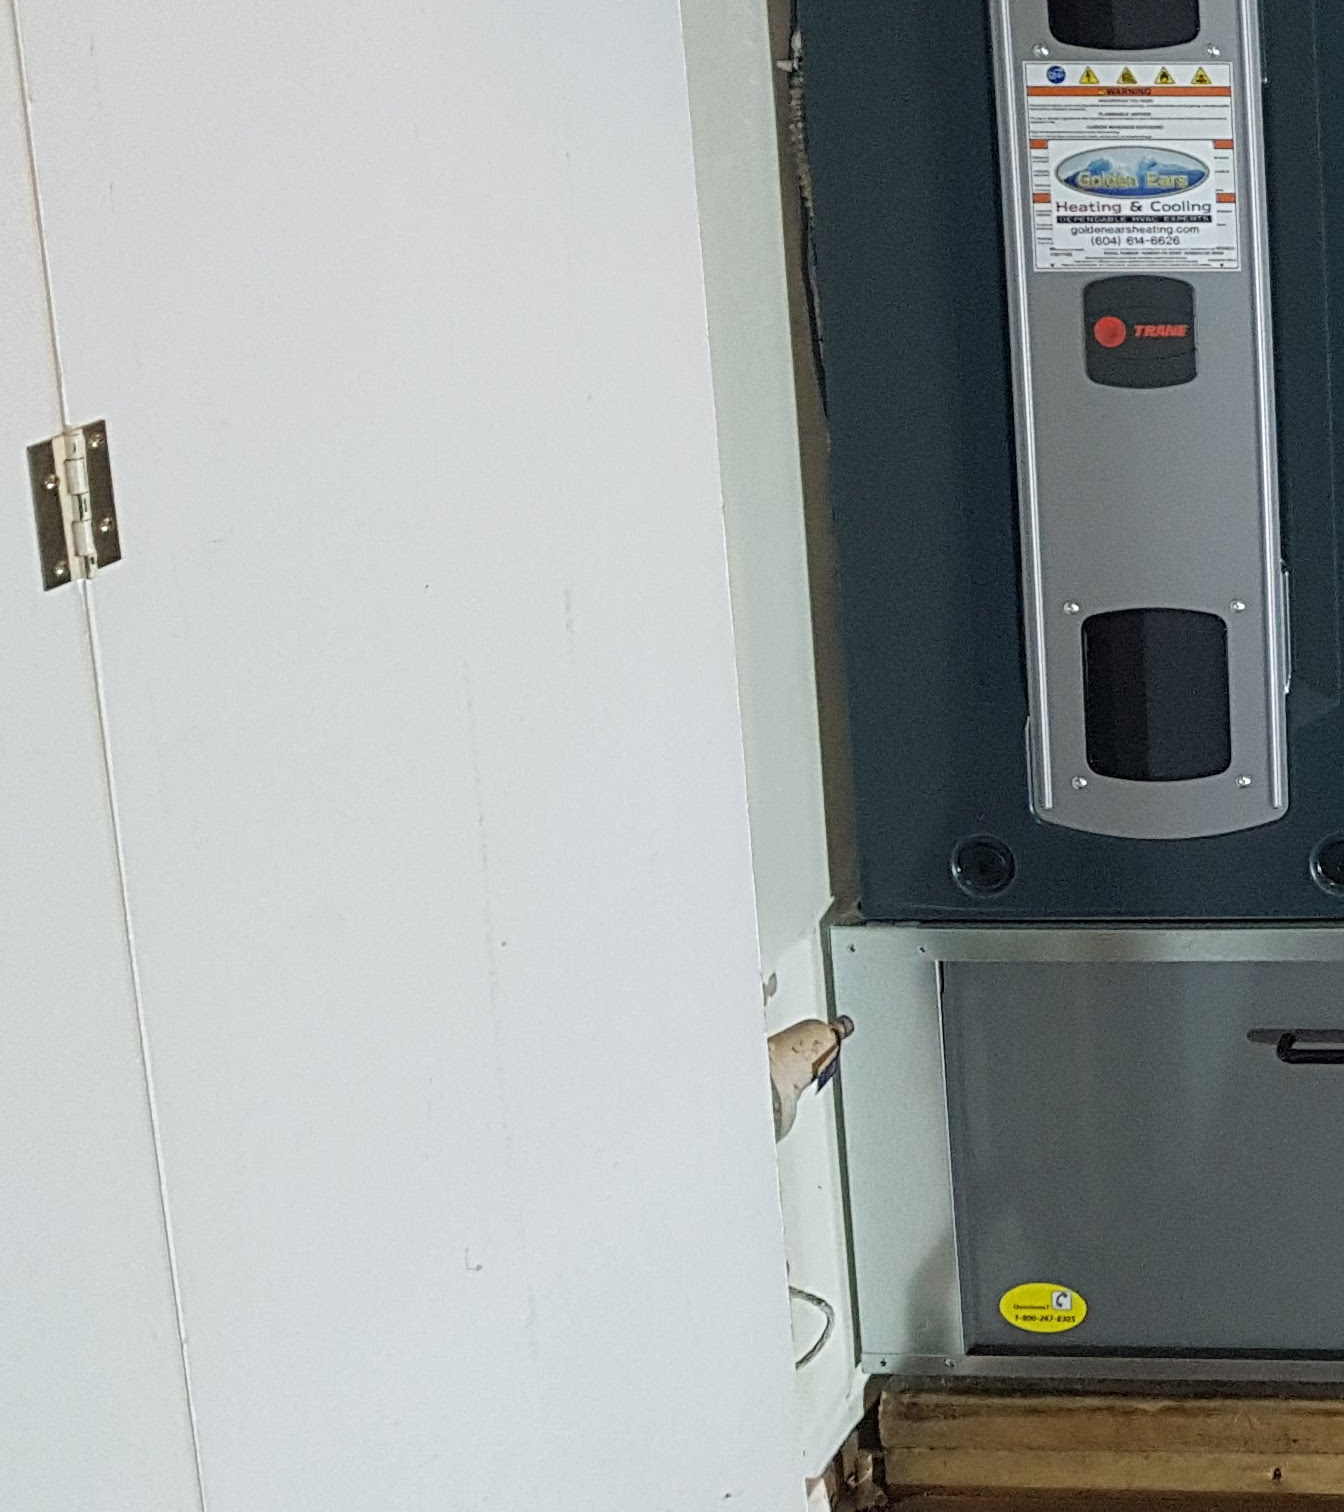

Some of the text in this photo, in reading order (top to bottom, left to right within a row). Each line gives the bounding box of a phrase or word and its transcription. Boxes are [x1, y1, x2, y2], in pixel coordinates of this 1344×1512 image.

[1106, 88, 1151, 96] WARNING
[1077, 172, 1189, 189] Golden Ears
[1056, 201, 1212, 215] Heating & Cooling
[1070, 225, 1200, 236] goldenearsheating.com
[1090, 235, 1180, 247] (604) 614-6626
[1133, 323, 1189, 338] TRANE
